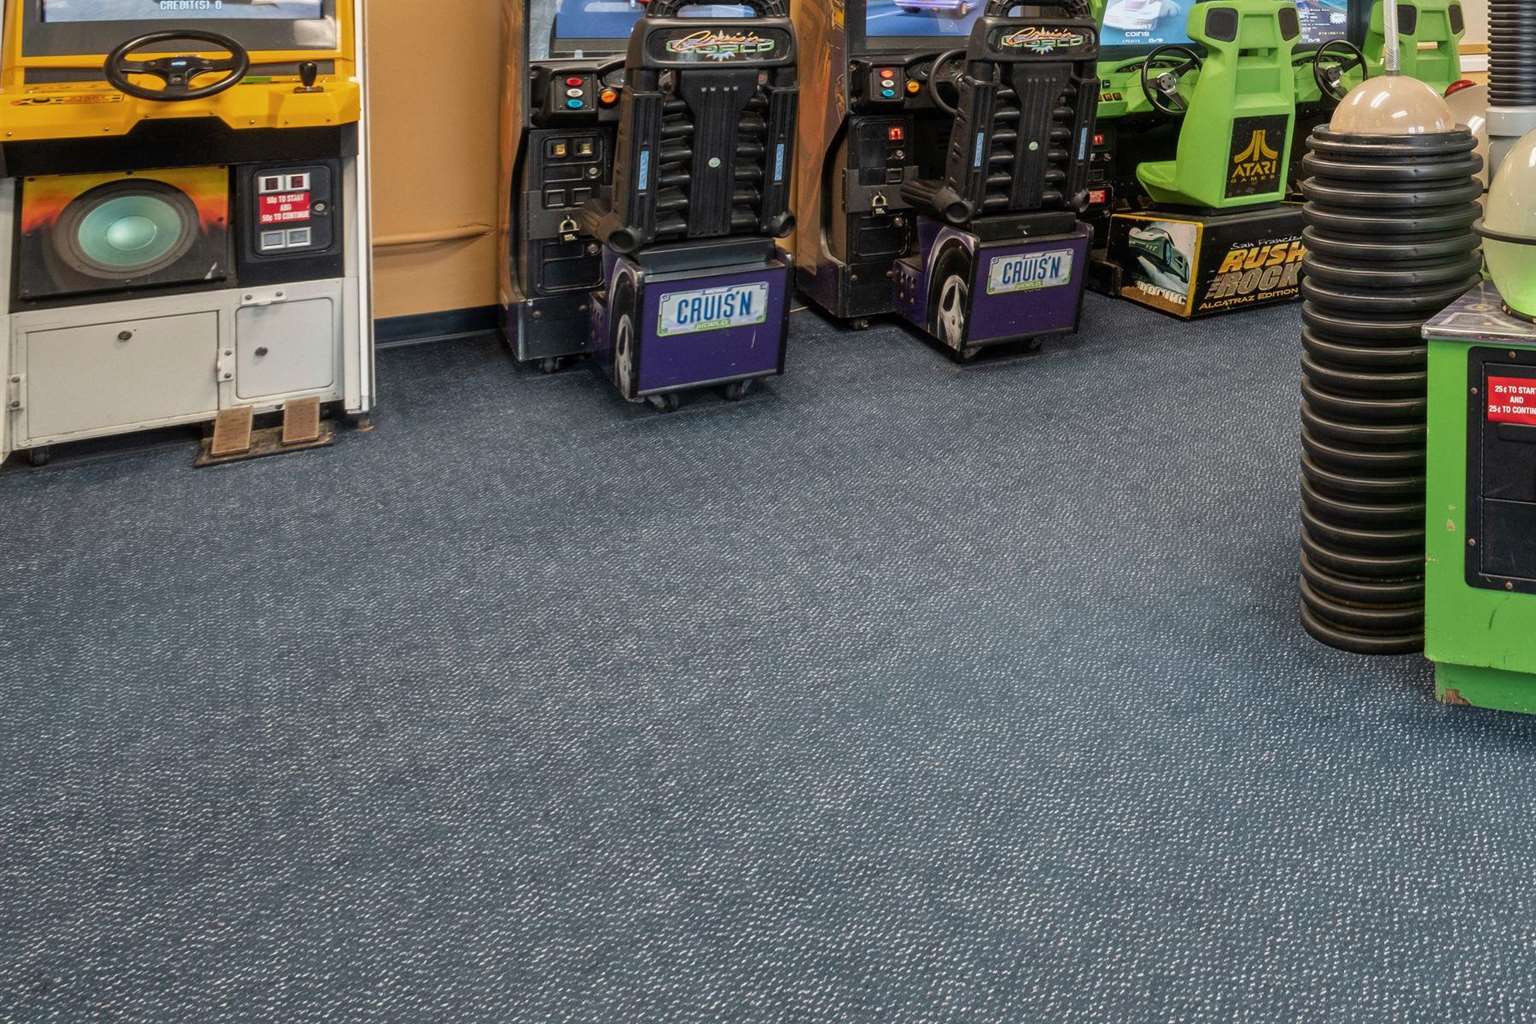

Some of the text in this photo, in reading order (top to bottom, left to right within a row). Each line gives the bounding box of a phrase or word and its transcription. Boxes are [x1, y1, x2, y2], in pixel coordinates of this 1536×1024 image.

[160, 0, 210, 10] CREDIT(S)
[1231, 160, 1277, 178] ATARI
[1230, 241, 1255, 250] San
[1218, 240, 1308, 274] RUSH
[1002, 255, 1061, 285] CRUIS'N
[1213, 261, 1302, 299] ROCK
[676, 290, 753, 324] CRUIS'N
[1198, 287, 1299, 311] ALCATRAZ EDITION
[1508, 385, 1517, 394] TO
[1510, 395, 1524, 404] AND
[1502, 405, 1512, 414] TO
